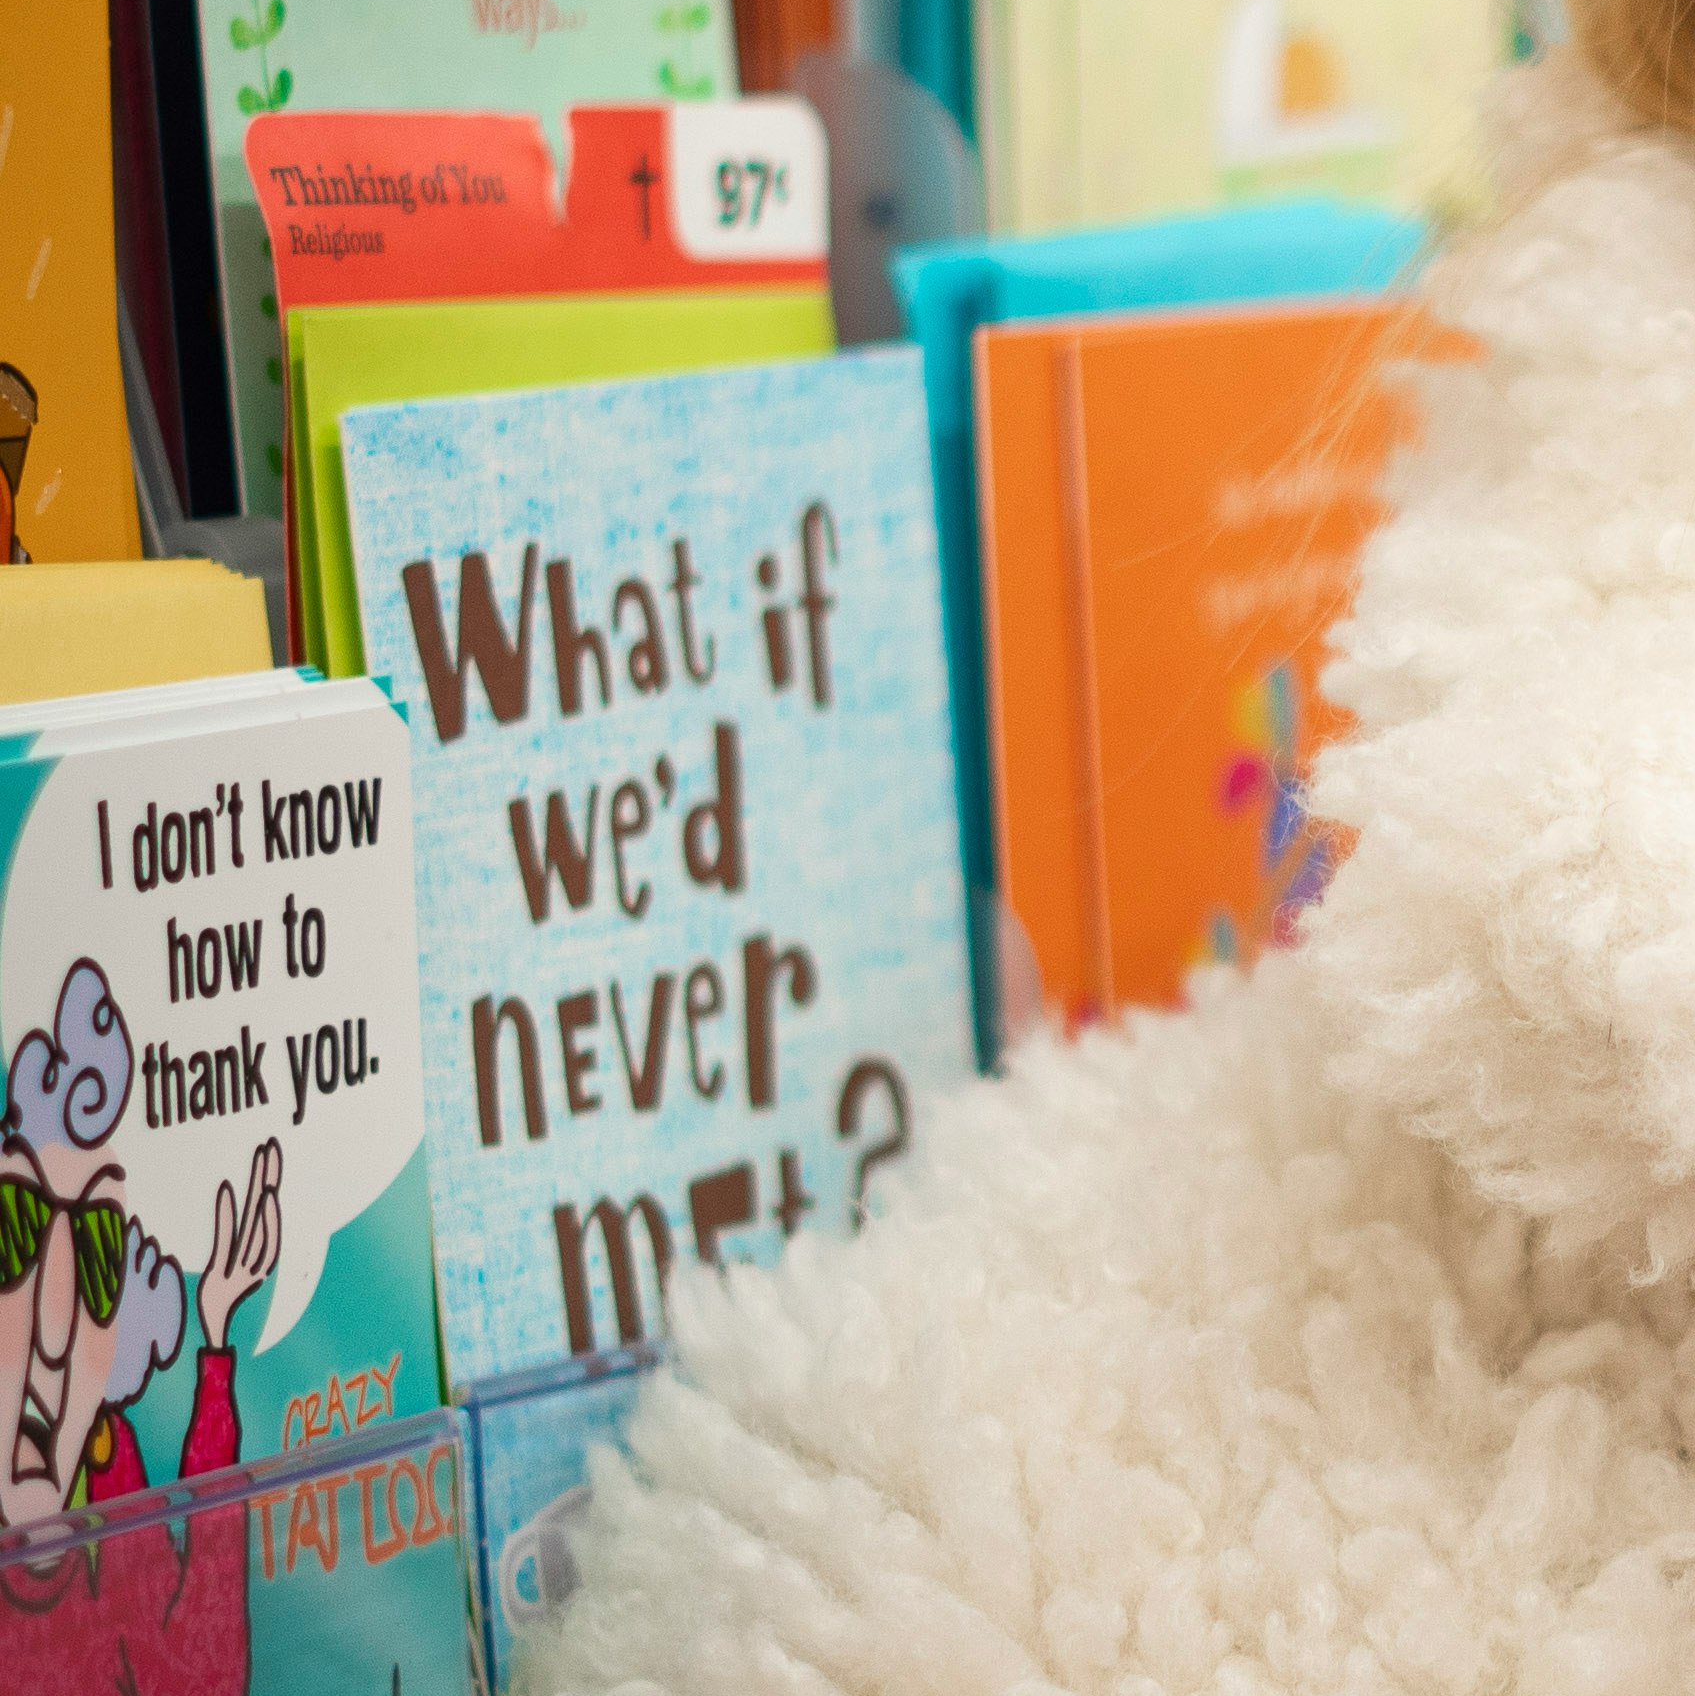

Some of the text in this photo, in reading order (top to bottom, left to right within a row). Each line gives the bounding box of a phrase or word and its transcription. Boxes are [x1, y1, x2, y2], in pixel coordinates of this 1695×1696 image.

[271, 165, 508, 212] Thinking of You
[288, 226, 384, 259] Religious
[403, 501, 840, 743] What if
[98, 777, 381, 892] I don't know
[509, 719, 748, 924] we'd
[167, 894, 326, 1004] how to
[143, 1018, 379, 1129] thank you.
[282, 1353, 401, 1456] CRAZY
